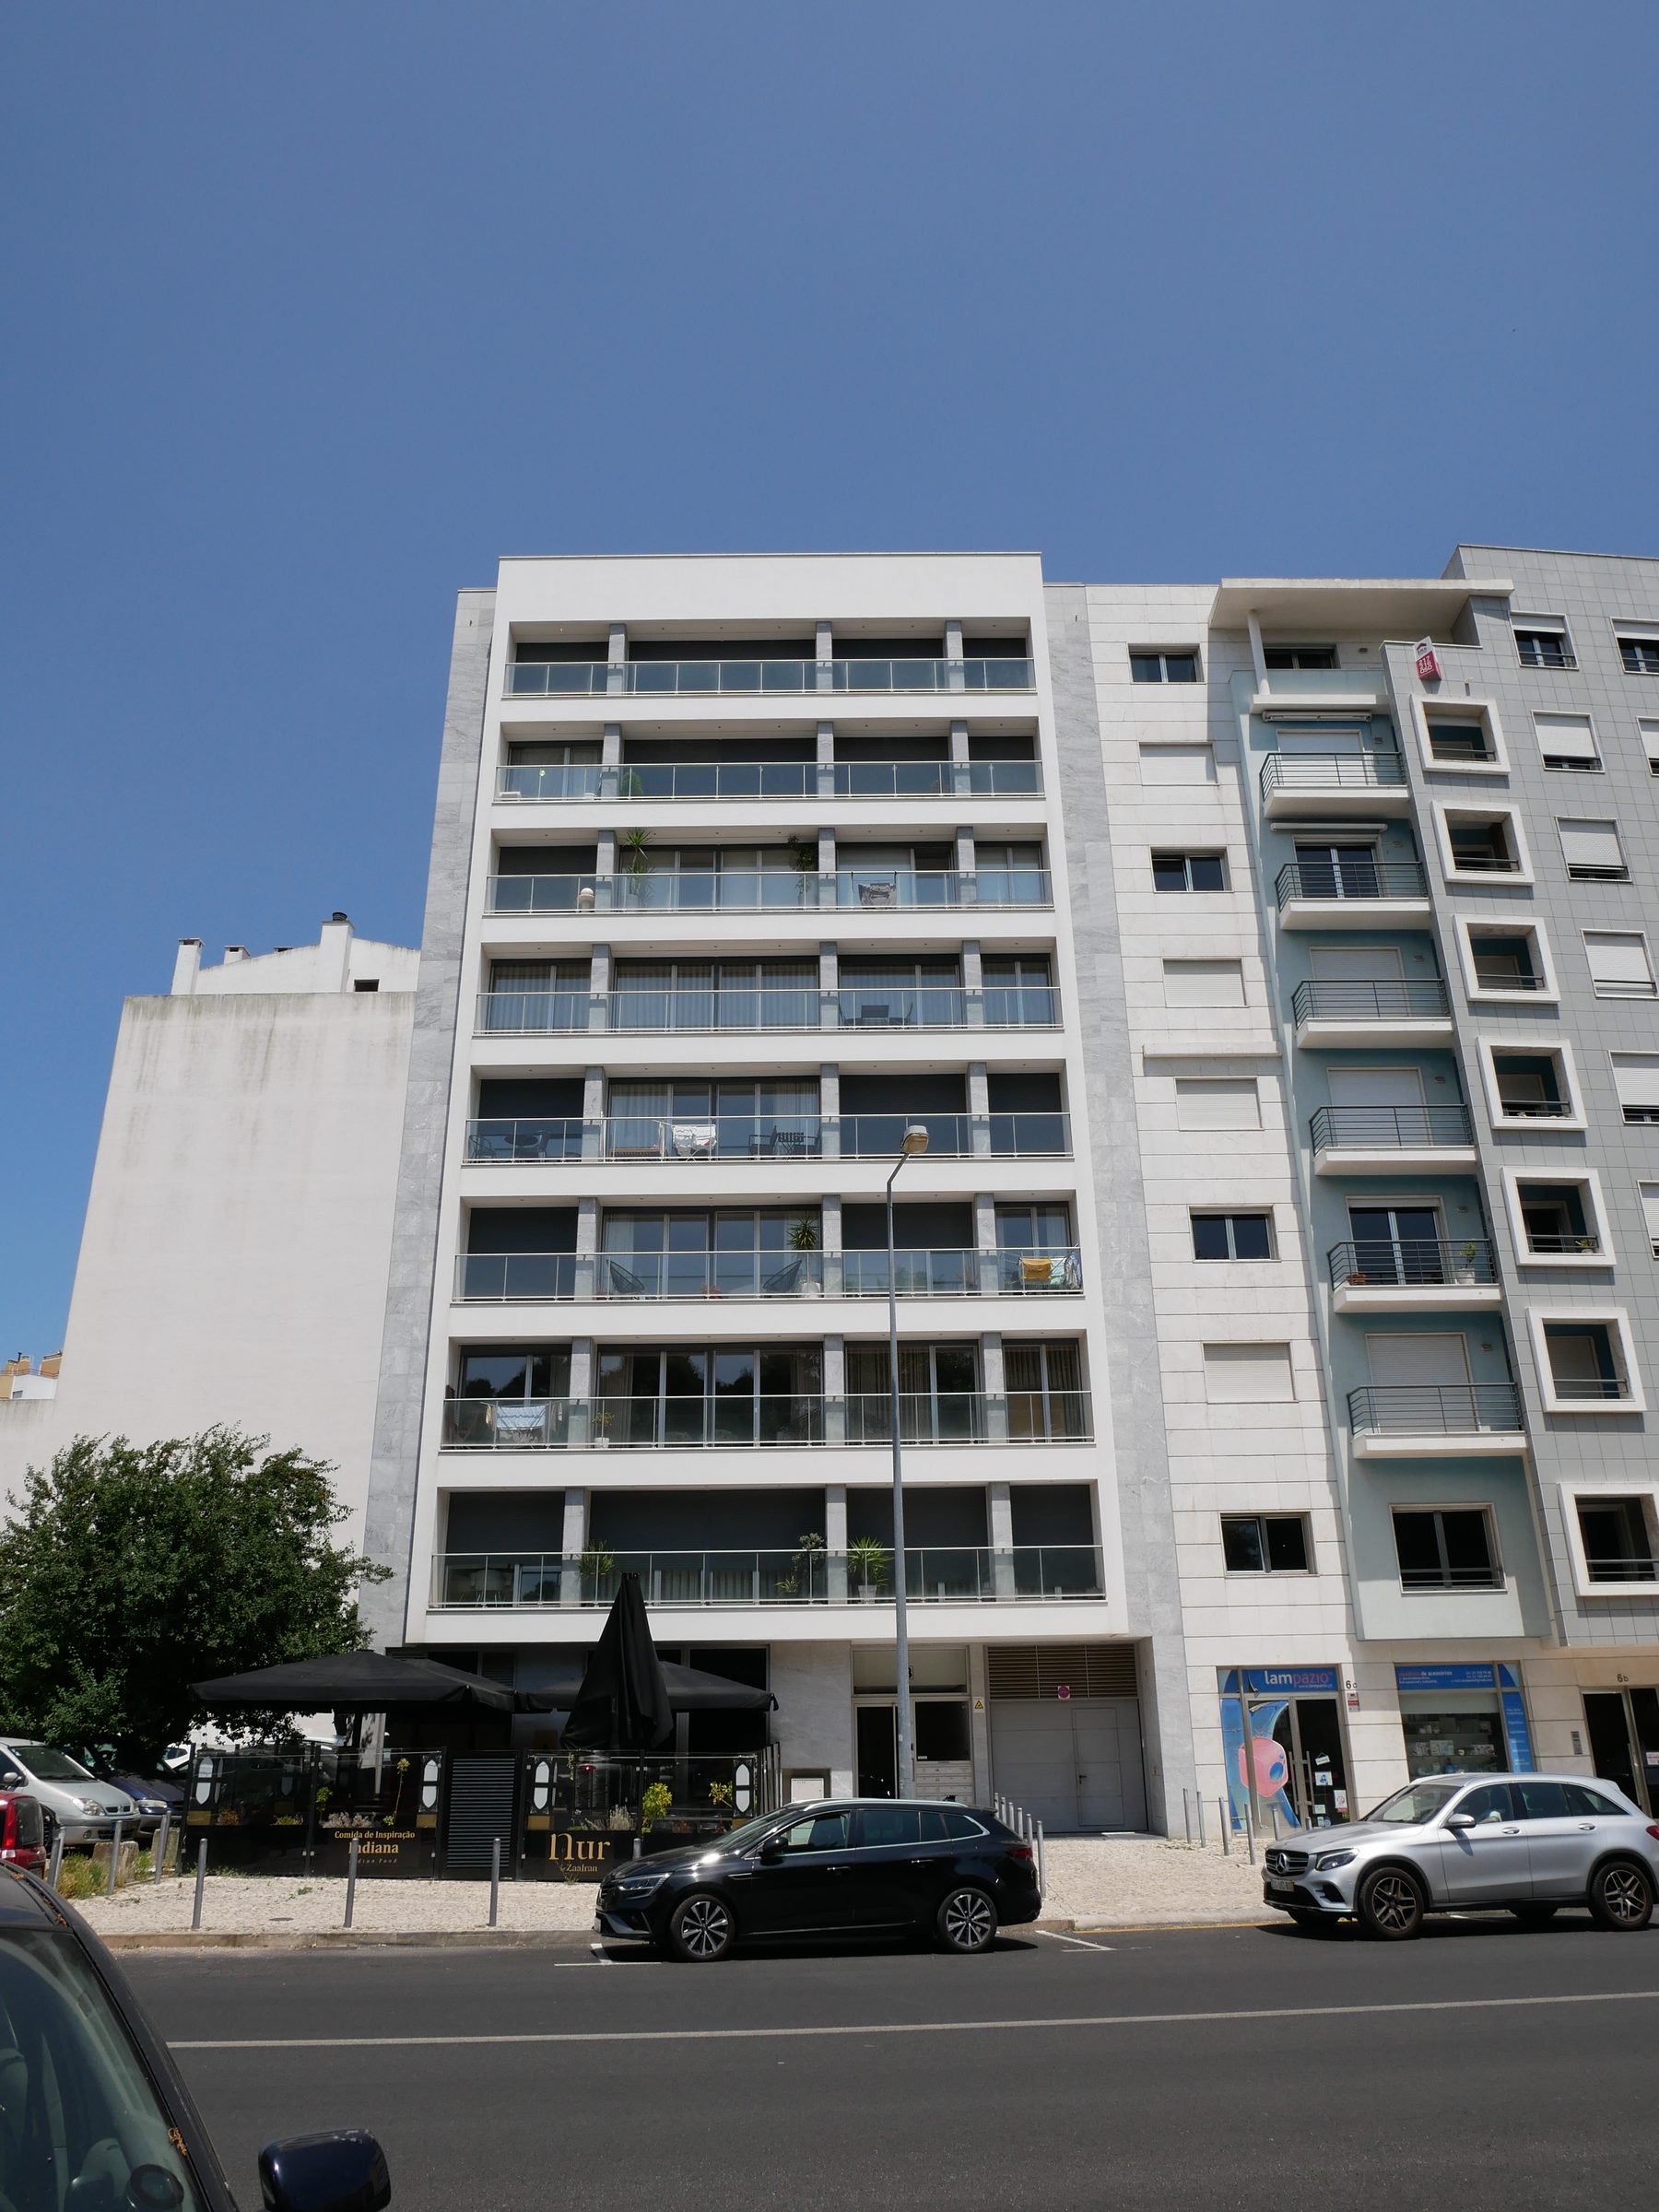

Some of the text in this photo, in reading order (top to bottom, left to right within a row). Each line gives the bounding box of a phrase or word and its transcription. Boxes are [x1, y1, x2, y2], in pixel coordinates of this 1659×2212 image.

[1264, 1670, 1328, 1688] lampazio
[335, 1830, 416, 1840] Comida de Inspiração
[548, 1832, 611, 1860] Nur
